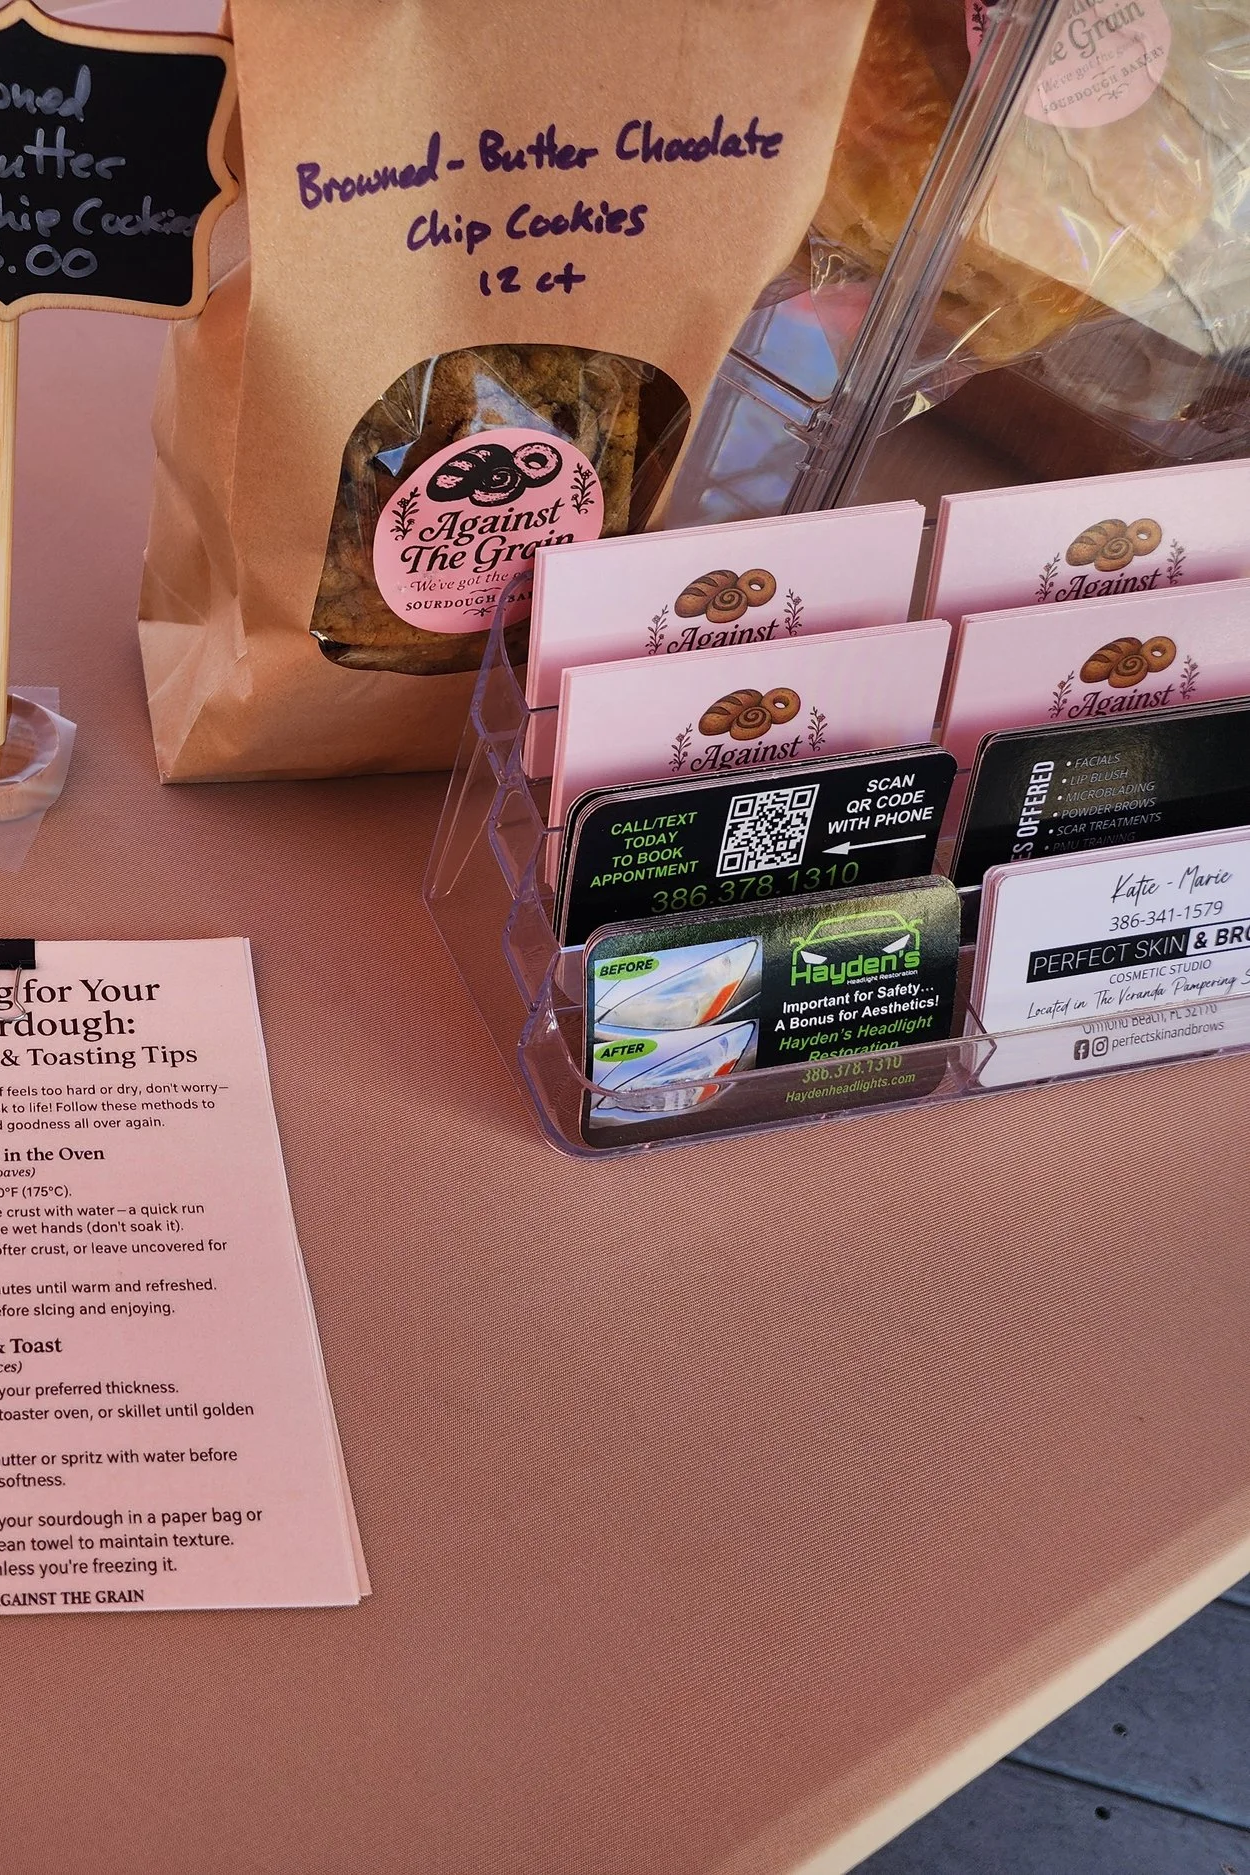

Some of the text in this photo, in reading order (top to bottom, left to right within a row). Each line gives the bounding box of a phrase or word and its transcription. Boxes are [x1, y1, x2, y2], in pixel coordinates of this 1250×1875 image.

[1068, 1, 1145, 59] Grain
[406, 201, 648, 255] Chip Cookies
[418, 498, 565, 546] Against
[400, 544, 466, 574] The
[411, 579, 454, 592] We've
[457, 576, 480, 590] got
[486, 571, 508, 581] the
[1055, 568, 1162, 601] Against
[406, 595, 496, 611] SOURDOUGH
[667, 619, 779, 654] Against
[1068, 684, 1175, 718] Against
[690, 735, 803, 771] Against
[1074, 753, 1121, 768] FACIALS
[867, 774, 915, 792] SCAN
[1070, 769, 1129, 785] LIP BLUSH
[847, 790, 925, 814] QR CODE
[1016, 760, 1054, 838] OFFERED
[1065, 781, 1155, 802] MICROBLADING
[828, 807, 934, 834] WITH PHONE
[1061, 797, 1157, 819] POWDER BROWS
[611, 812, 698, 835] CALL/TEXT
[1056, 812, 1162, 836] SCAR TREATMENTS
[624, 831, 678, 850] TODAY
[1052, 832, 1136, 851] PMU TRAINING
[612, 847, 684, 868] TO BOOK
[590, 860, 699, 888] APPONTMENT
[1110, 873, 1160, 906] Katie
[1178, 865, 1232, 894] Marie
[651, 861, 859, 913] 386.378.1310
[1109, 900, 1223, 932] 386-341-1579
[1032, 942, 1131, 976] PERFECT
[1134, 934, 1186, 959] SKIN
[1193, 931, 1207, 949] &
[600, 959, 653, 976] BEFORE
[790, 950, 921, 986] Hayden's
[846, 970, 918, 985] Headlight Restoration
[1109, 959, 1212, 985] COSMETIC STUDIO
[22, 978, 73, 1003] for
[79, 978, 161, 1003] Your
[783, 993, 850, 1014] Important
[854, 991, 873, 1005] for
[1027, 998, 1072, 1019] Located
[1074, 1001, 1087, 1010] in
[1094, 990, 1115, 1009] The
[1119, 984, 1166, 1005] Veranda
[1173, 975, 1238, 996] Pampering
[775, 995, 939, 1032] A Bonus for Aesthetics!
[779, 1015, 933, 1050] Hayden's Headlight
[1112, 1020, 1224, 1051] perfectskinandbrows
[0, 1048, 22, 1067] &
[25, 1046, 137, 1070] Toasting
[140, 1045, 198, 1069] Tips
[600, 1043, 645, 1058] AFTER
[6, 1085, 39, 1097] feels
[40, 1085, 63, 1097] too
[66, 1083, 96, 1096] hard
[99, 1086, 114, 1095] or
[116, 1083, 142, 1097] dry,
[145, 1082, 179, 1094] don't
[180, 1083, 229, 1096] worry—
[785, 1073, 916, 1102] Haydenheadlights.com
[3, 1147, 23, 1163] in
[25, 1146, 55, 1162] the
[58, 1146, 106, 1161] Oven
[33, 1302, 76, 1319] slcing
[79, 1301, 107, 1316] and
[110, 1300, 176, 1318] enjoying.
[8, 1337, 64, 1354] Toast
[59, 1590, 92, 1605] THE
[94, 1588, 145, 1604] GRAIN
